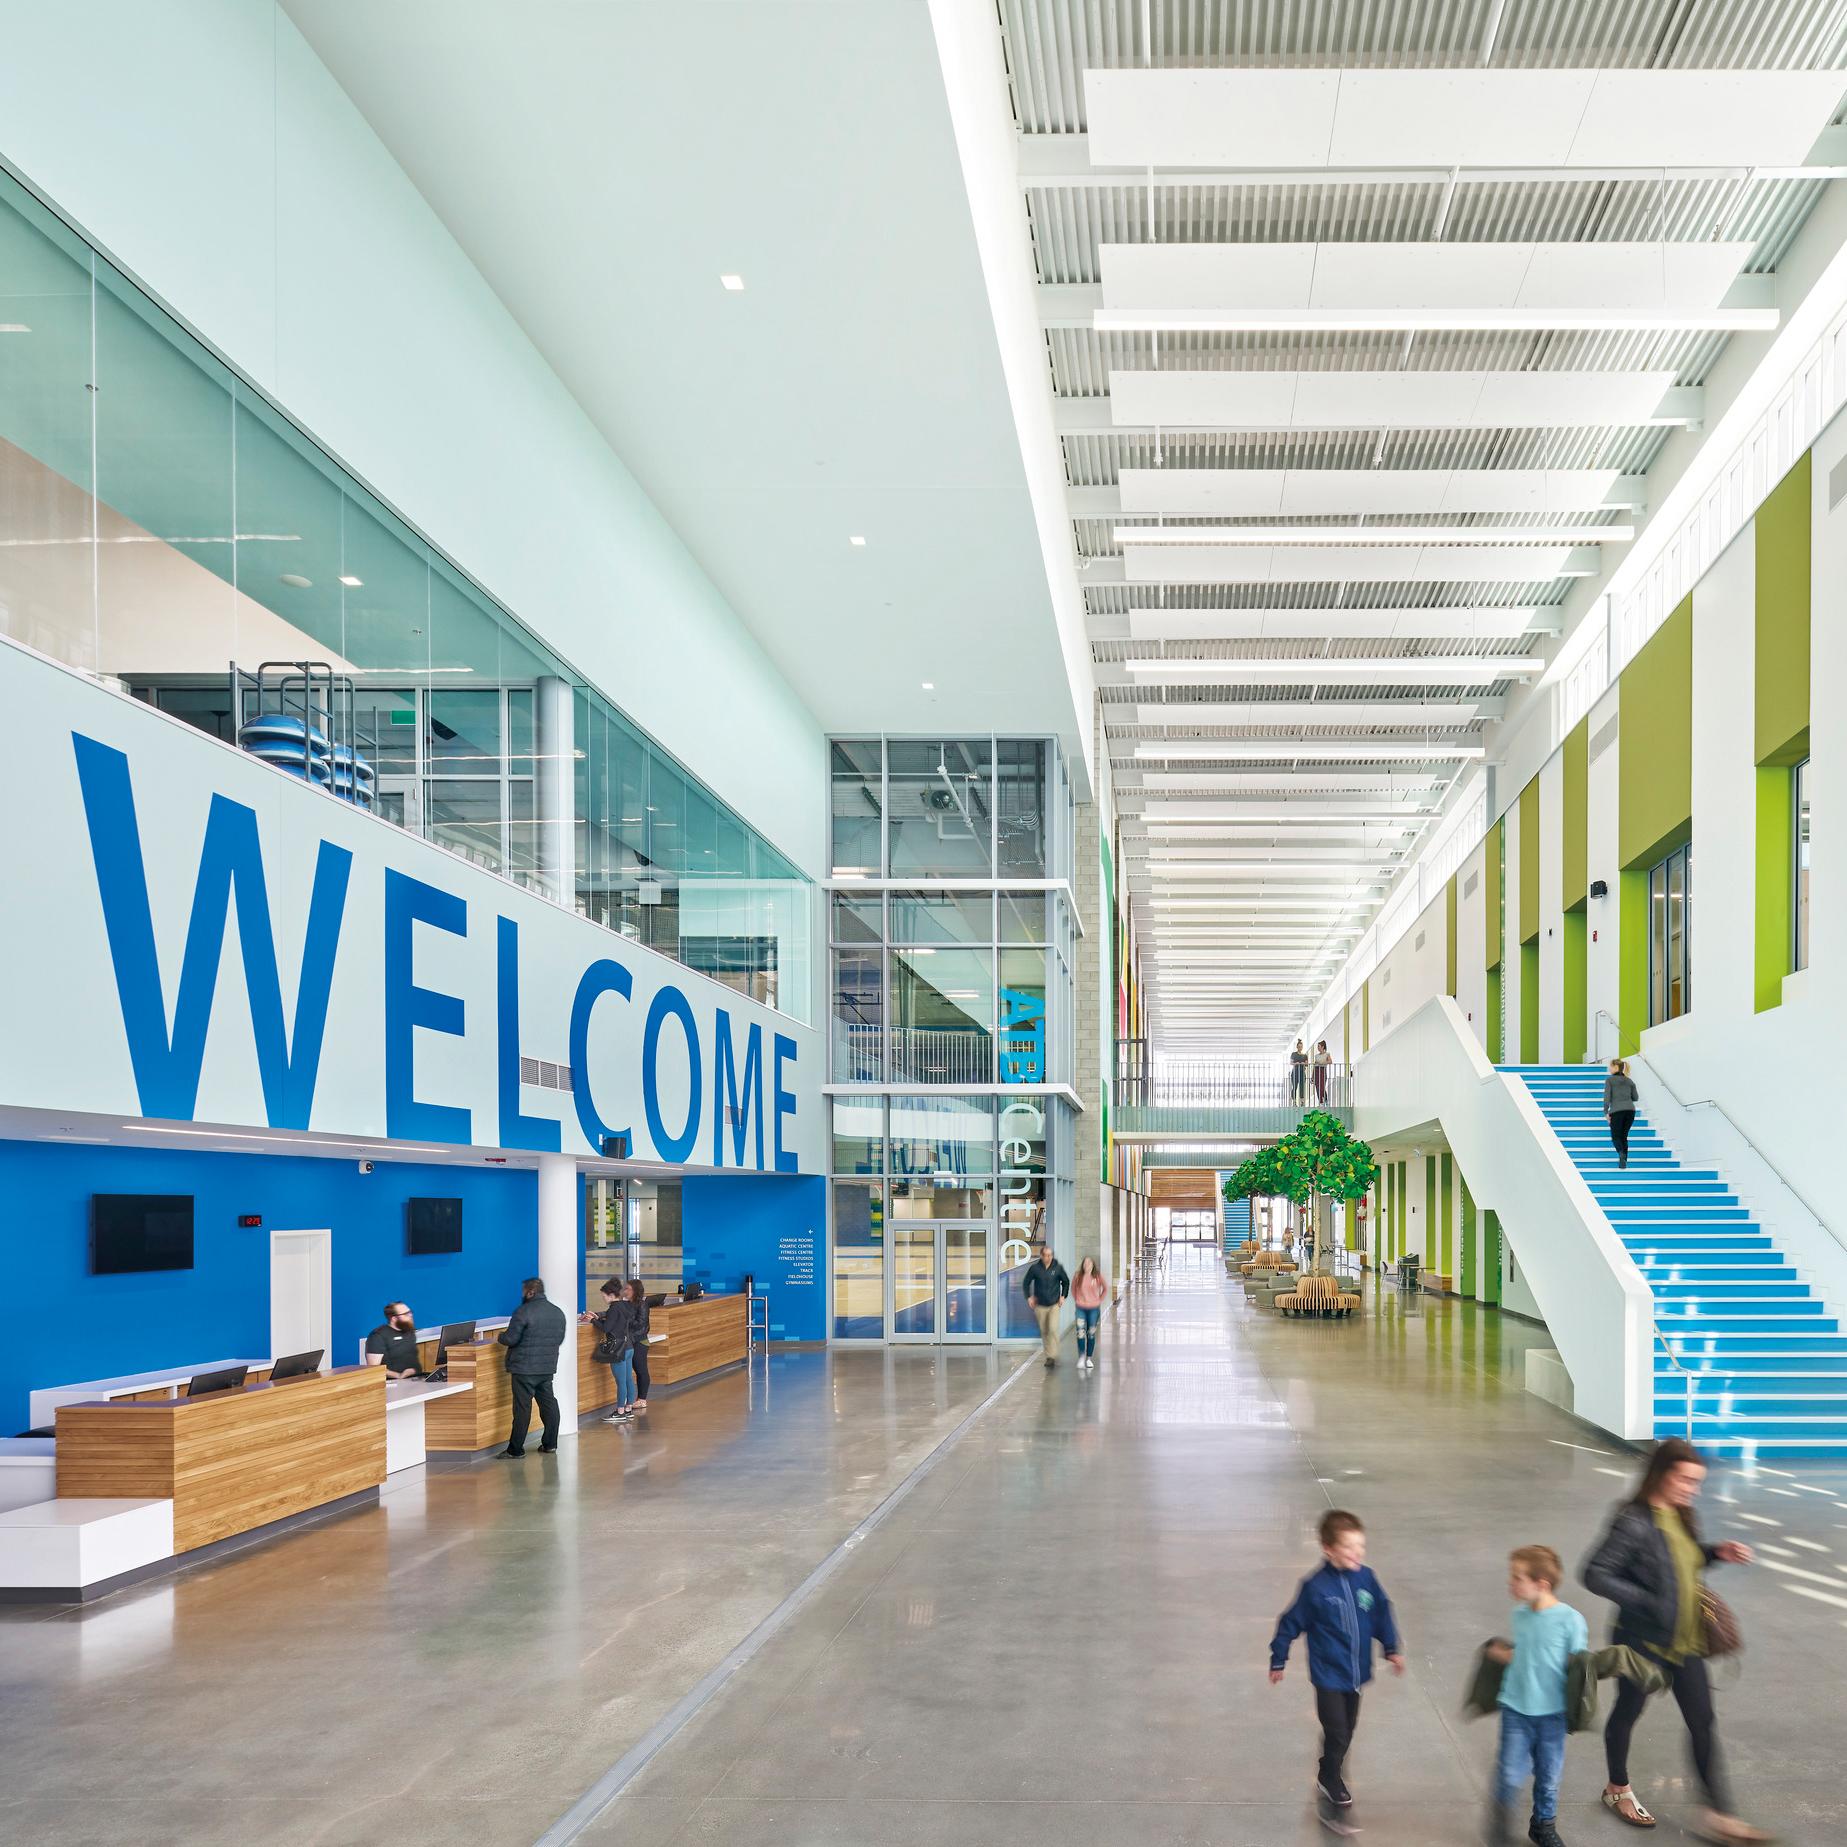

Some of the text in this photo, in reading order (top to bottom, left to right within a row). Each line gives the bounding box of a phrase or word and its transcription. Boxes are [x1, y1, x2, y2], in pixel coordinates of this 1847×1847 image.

[71, 730, 799, 1174] WELCOME
[999, 987, 1046, 1267] ATB Centre
